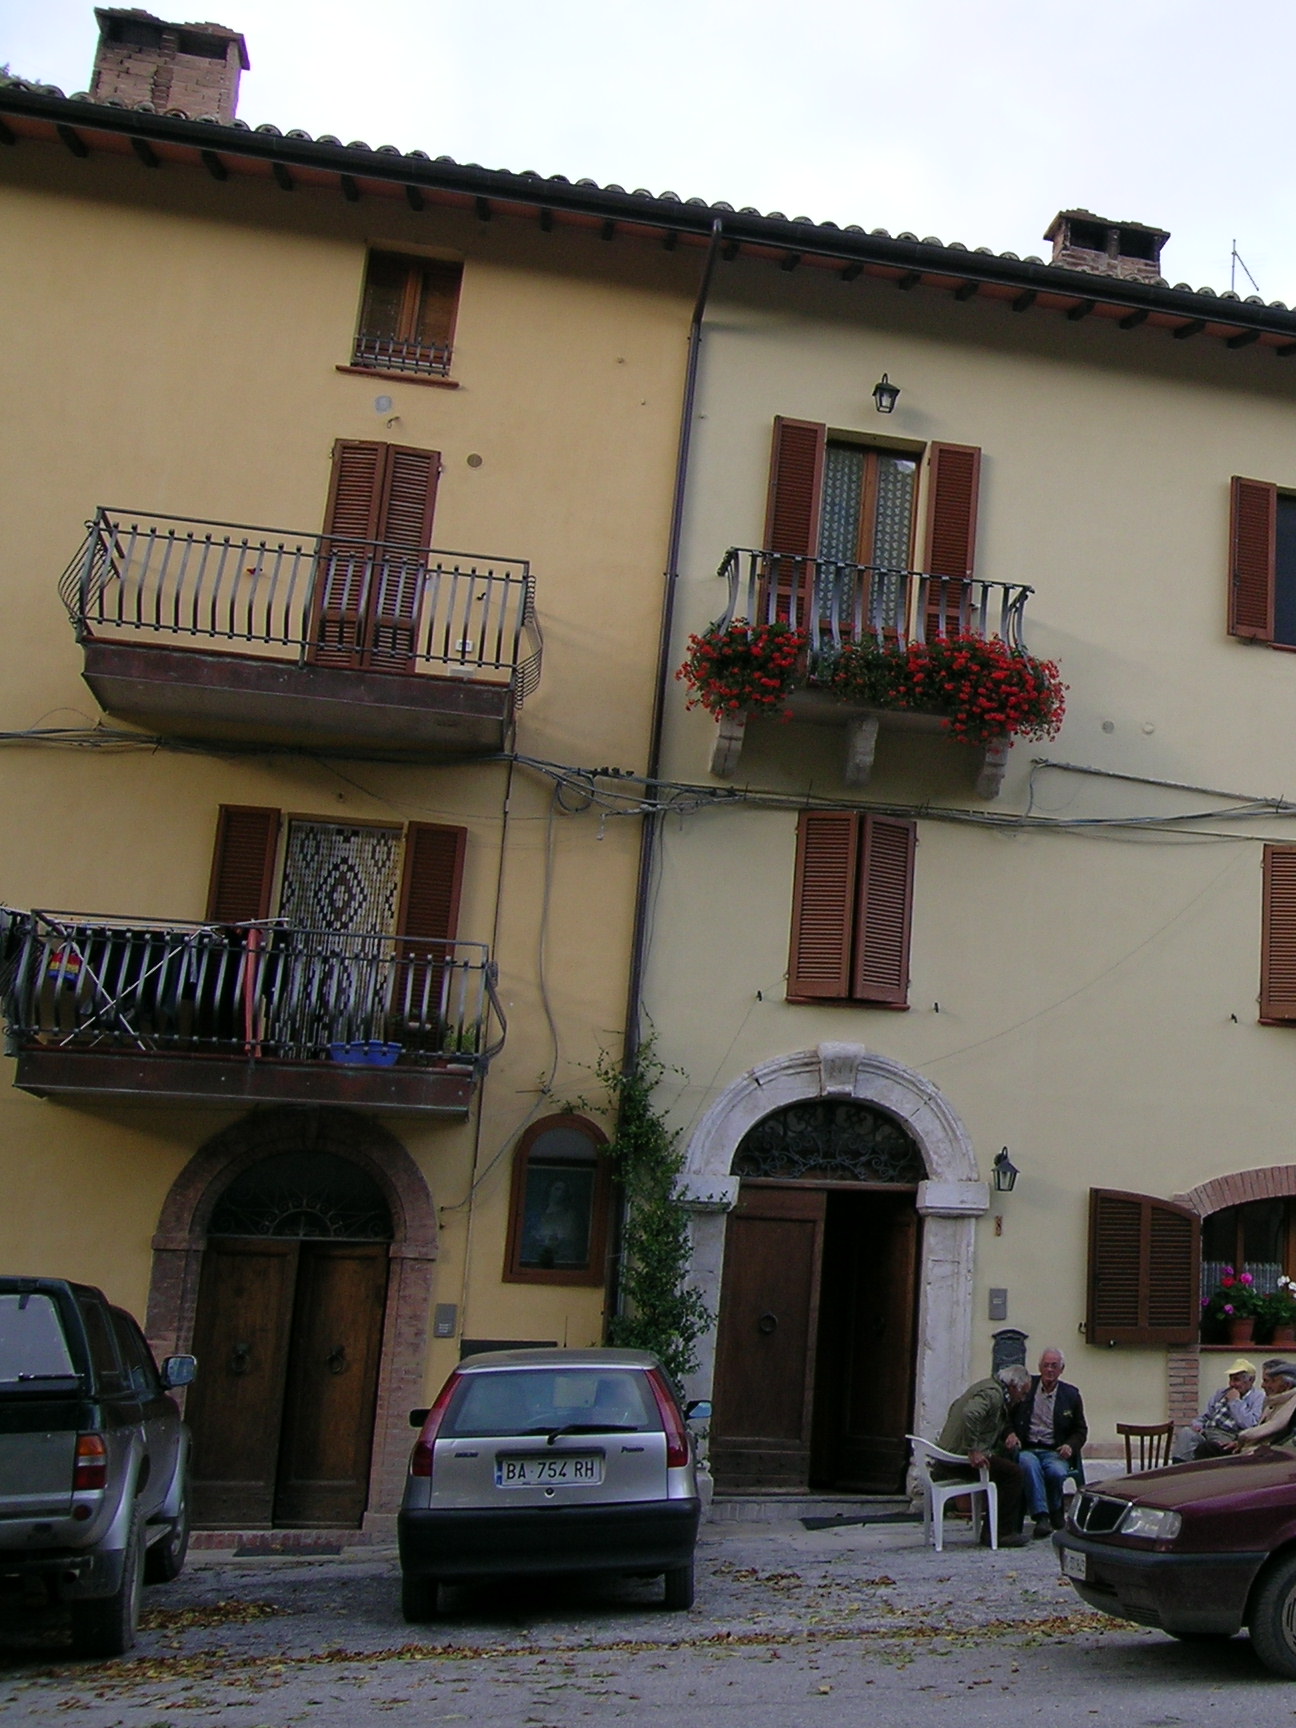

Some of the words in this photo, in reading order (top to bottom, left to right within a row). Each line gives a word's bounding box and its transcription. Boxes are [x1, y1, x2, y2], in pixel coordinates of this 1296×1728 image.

[506, 1462, 526, 1480] BA
[537, 1461, 567, 1479] 754
[574, 1459, 594, 1478] RH
